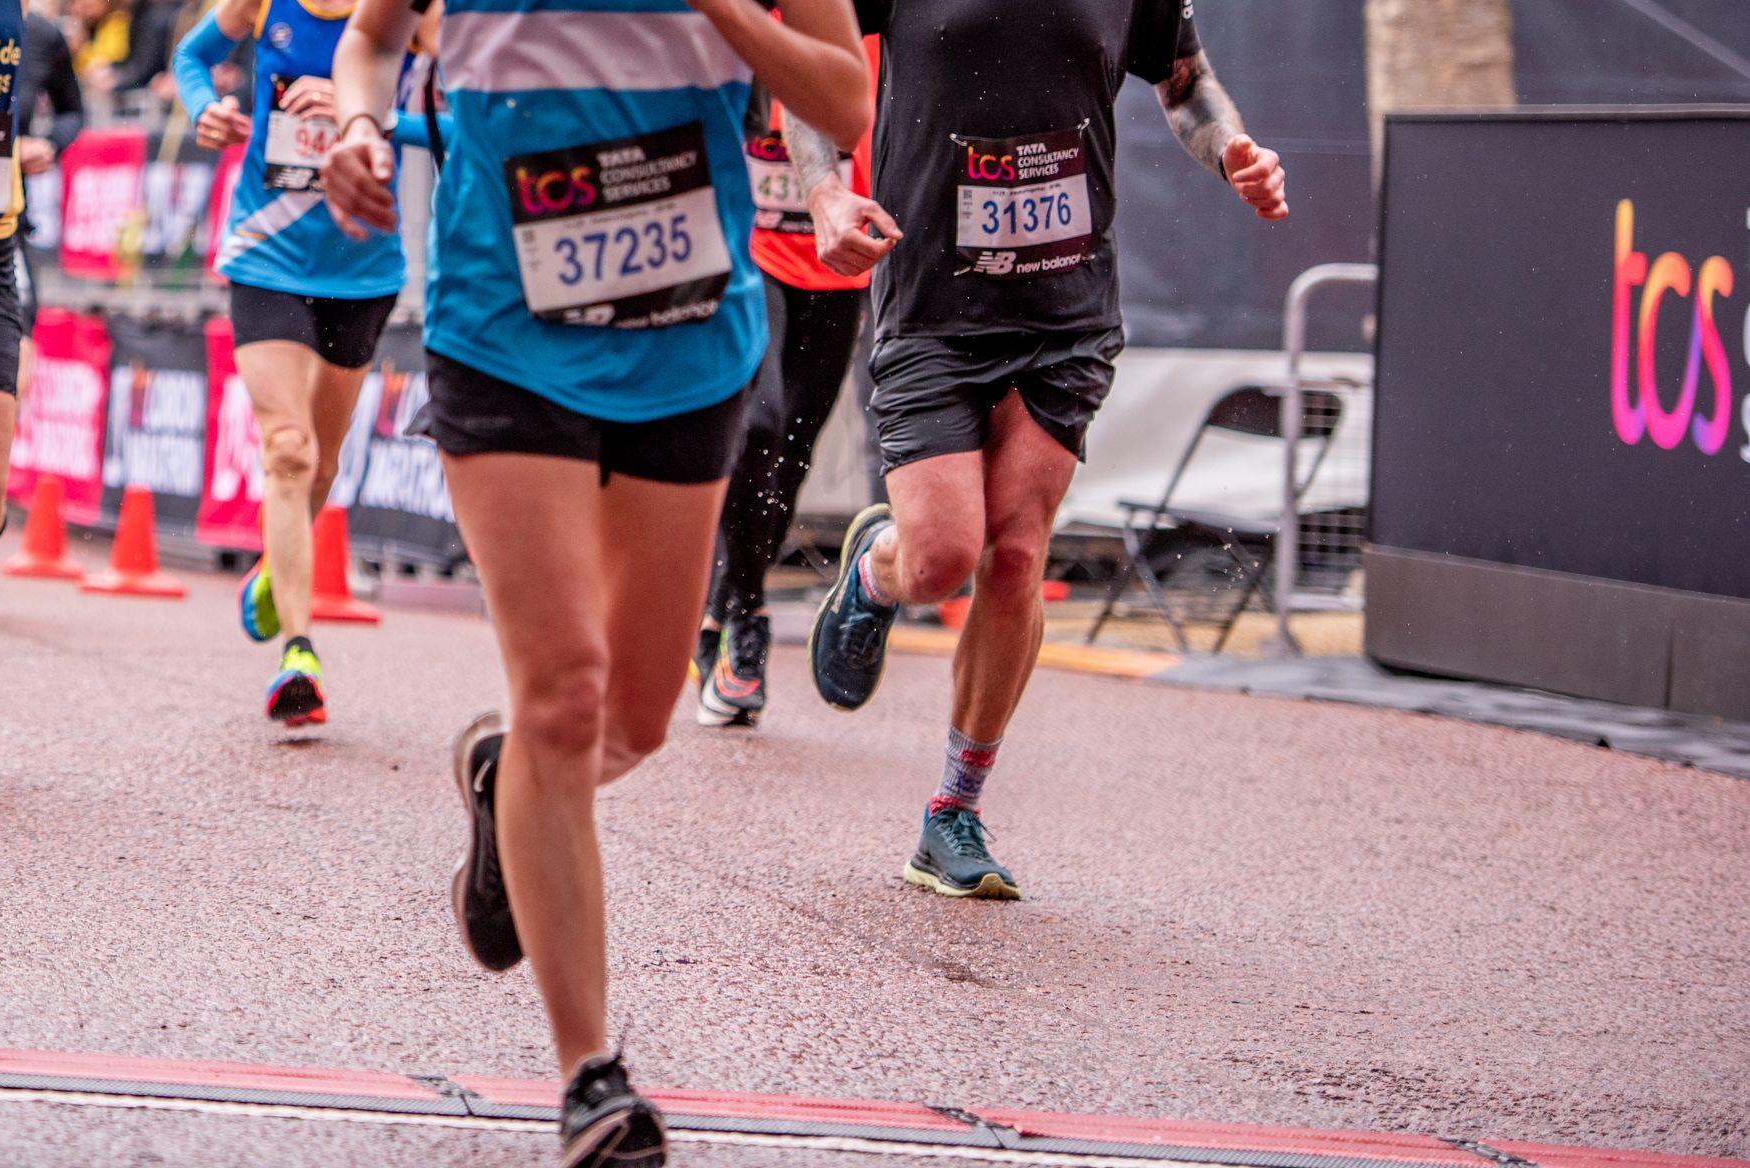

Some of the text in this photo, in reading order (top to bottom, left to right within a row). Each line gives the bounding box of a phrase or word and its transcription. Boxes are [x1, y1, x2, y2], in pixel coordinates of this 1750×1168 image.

[596, 146, 646, 168] TATA
[967, 146, 1016, 181] tcs
[1016, 142, 1048, 157] TATA
[1017, 148, 1080, 168] CONSULTANCY
[1018, 163, 1060, 180] SERVICES
[515, 165, 597, 214] tcs
[981, 192, 1072, 234] 31376
[554, 214, 693, 285] 37235
[1016, 261, 1041, 273] new
[1611, 197, 1744, 456] tcs
